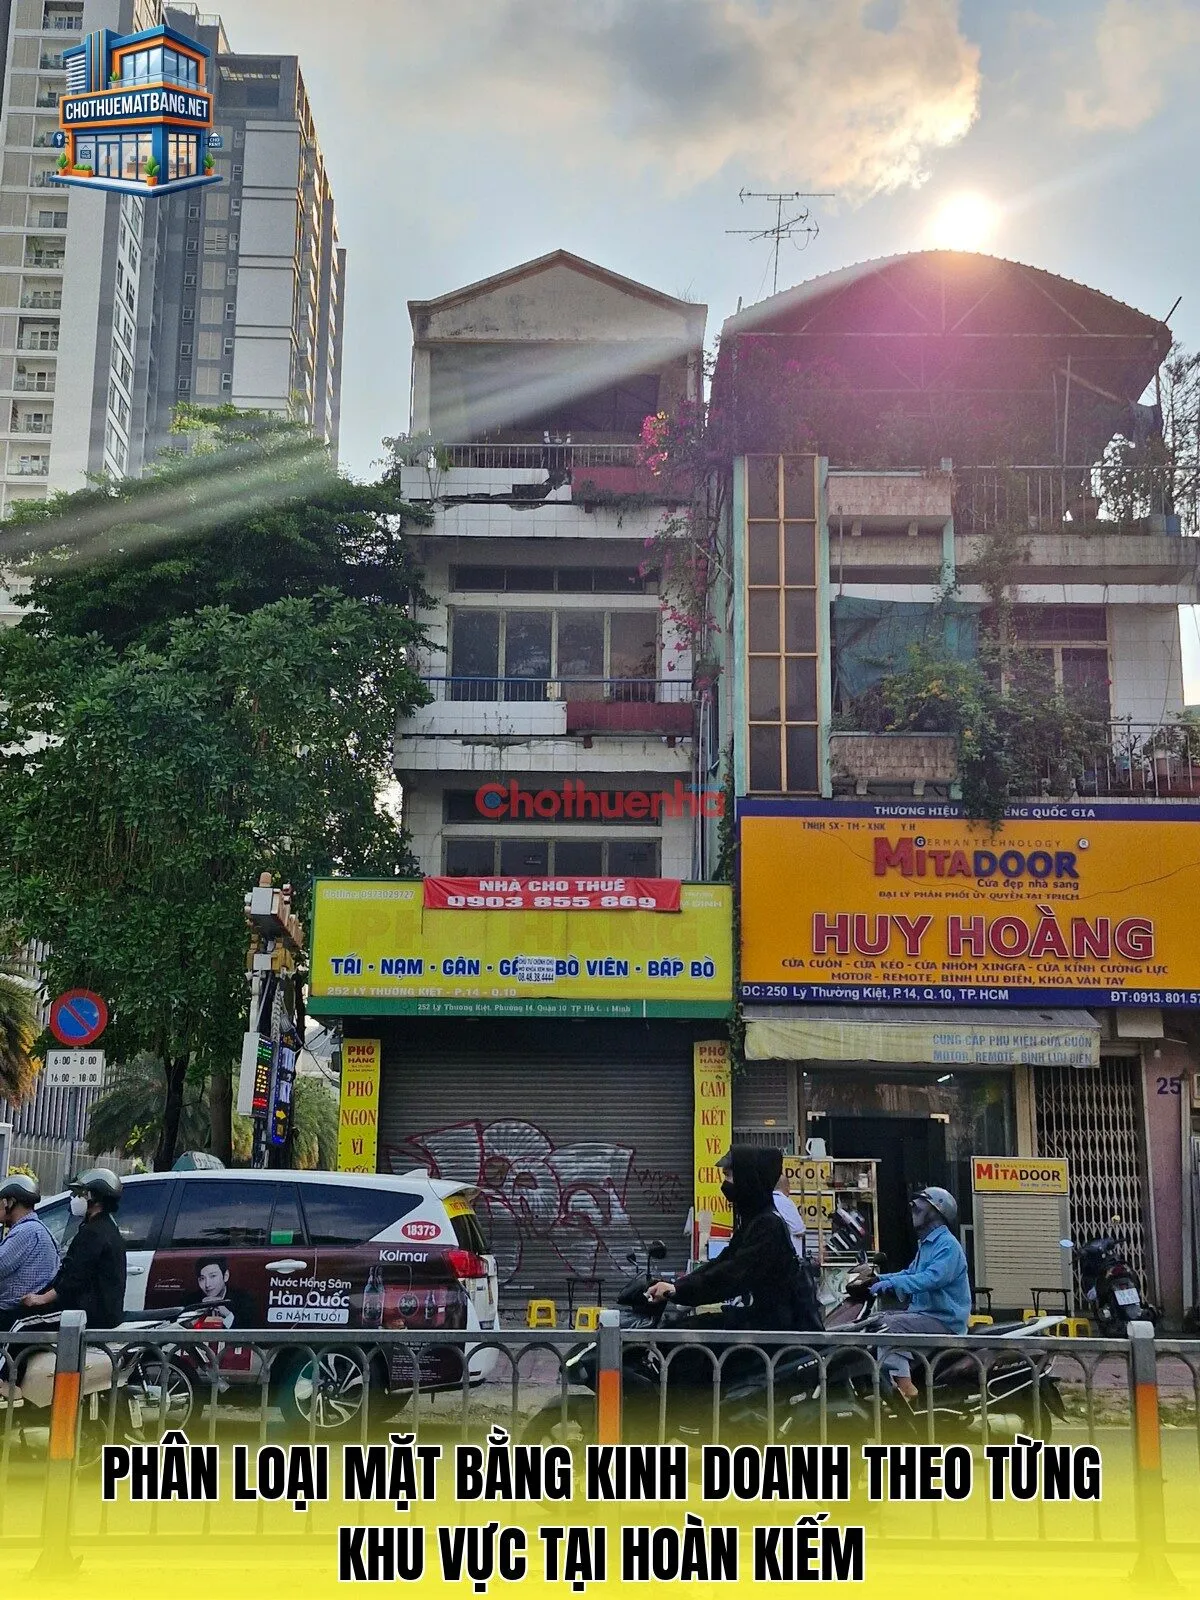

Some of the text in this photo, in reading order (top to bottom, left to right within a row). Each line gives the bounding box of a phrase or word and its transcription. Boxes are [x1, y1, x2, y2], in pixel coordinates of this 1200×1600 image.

[874, 806, 926, 816] THƯƠNG
[928, 807, 958, 818] HIỆU
[1032, 804, 1068, 818] QUỐC
[1071, 808, 1096, 818] GIA
[480, 878, 626, 892] NHÀ CHO THUÊ
[977, 878, 1080, 890] Cửa đẹp nhà sang
[447, 896, 657, 909] 0903 855 869
[812, 903, 1155, 961] HUY HOÀNG
[330, 952, 362, 976] TÁI
[380, 957, 424, 980] NẠM
[442, 955, 480, 977] GÂN
[555, 954, 580, 977] BÒ
[586, 956, 629, 978] VIÊN
[690, 955, 716, 979] BÒ
[880, 959, 904, 969] KÉO
[982, 962, 1026, 972] XINGFA
[832, 972, 872, 980] MOTOR
[882, 974, 936, 983] REMOTE,
[941, 972, 972, 982] BÌNH
[1105, 977, 1126, 986] TAY
[327, 987, 349, 996] 252
[454, 988, 480, 997] P.14
[491, 989, 516, 998] Q.10
[793, 987, 806, 1000] Lý
[810, 986, 860, 1000] Thường
[862, 986, 891, 1001] Kiệt,
[418, 1004, 430, 1012] 252
[572, 1004, 581, 1012] TP
[54, 1056, 97, 1065] 6:00 8:00
[51, 1073, 97, 1082] 16:00 18:00
[347, 1076, 374, 1097] PHỞ
[342, 1109, 376, 1126] NGON
[700, 1105, 726, 1126] KẾT
[406, 1224, 437, 1237] 18373
[379, 1248, 428, 1262] Kolmar
[270, 1276, 352, 1292] Nước Hồng Sâm
[268, 1290, 350, 1307] Hàn Quốc
[276, 1312, 282, 1320] 6
